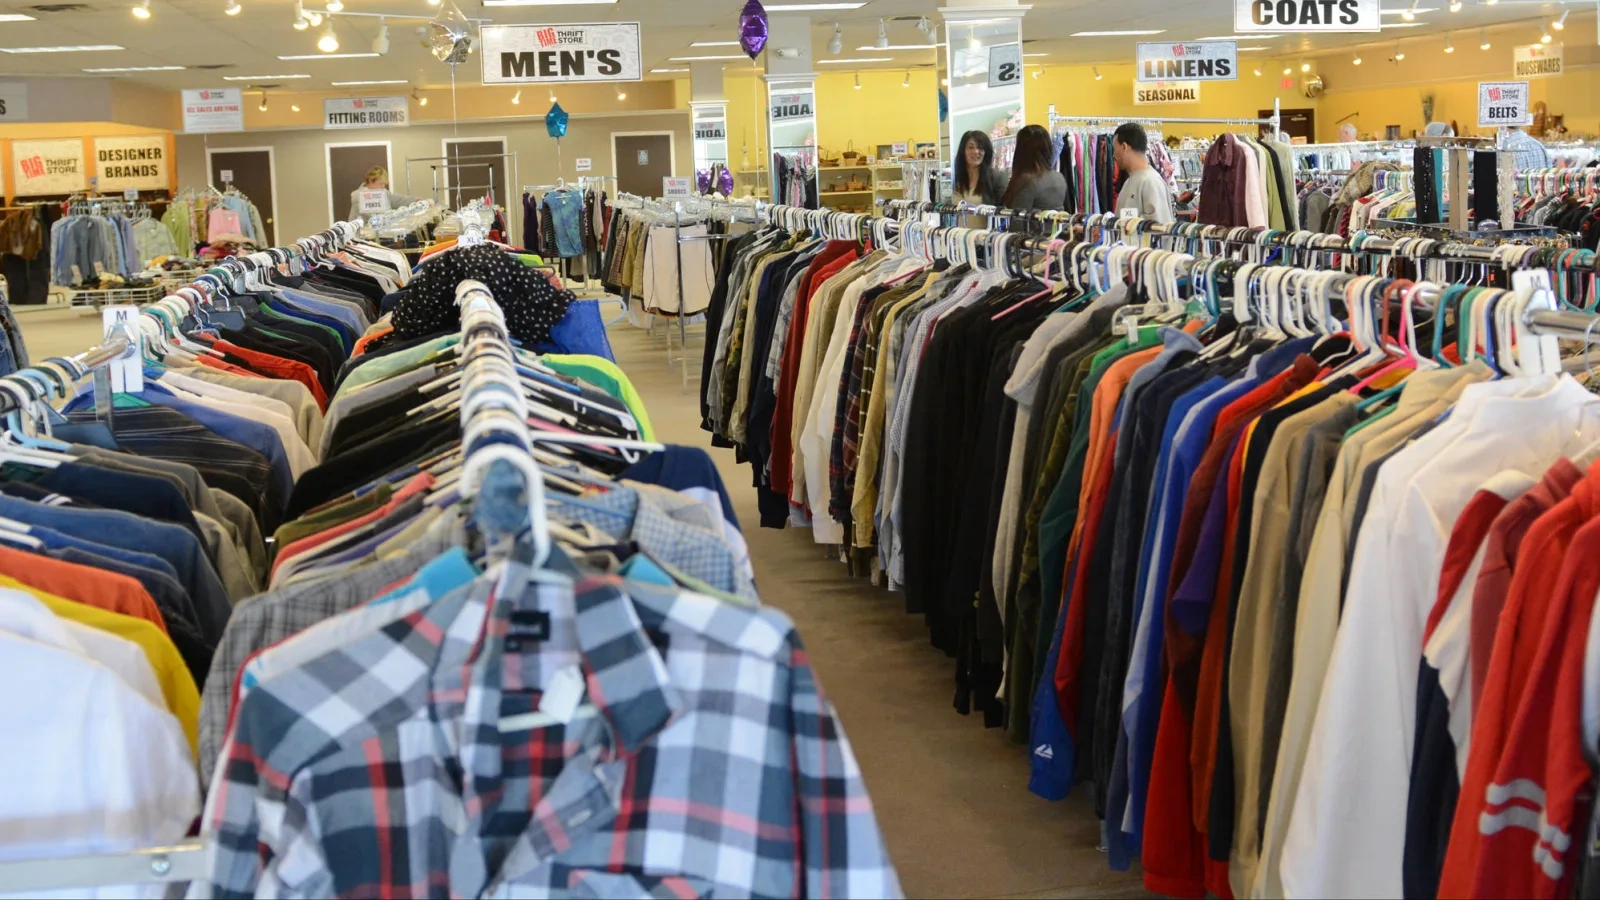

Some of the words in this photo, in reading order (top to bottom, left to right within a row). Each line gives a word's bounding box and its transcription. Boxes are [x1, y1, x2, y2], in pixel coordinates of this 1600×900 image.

[1252, 0, 1359, 25] COATS
[536, 27, 555, 41] BIG
[539, 37, 557, 48] TIME
[501, 49, 622, 78] MEN'S
[1145, 58, 1231, 78] LINENS
[1516, 57, 1561, 76] HOUSEWARES
[1138, 88, 1196, 102] SEASONAL
[1488, 87, 1501, 97] BIG
[329, 111, 367, 124] FITTING
[369, 110, 405, 123] ROOMS
[1489, 106, 1518, 119] BELTS
[46, 158, 78, 166] THRIFT
[99, 148, 162, 162] DESIGNER
[20, 155, 43, 174] BIG
[46, 166, 78, 175] STORE
[105, 164, 159, 178] BRANDS
[466, 235, 476, 243] XL
[1530, 275, 1542, 288] M
[116, 310, 127, 322] M
